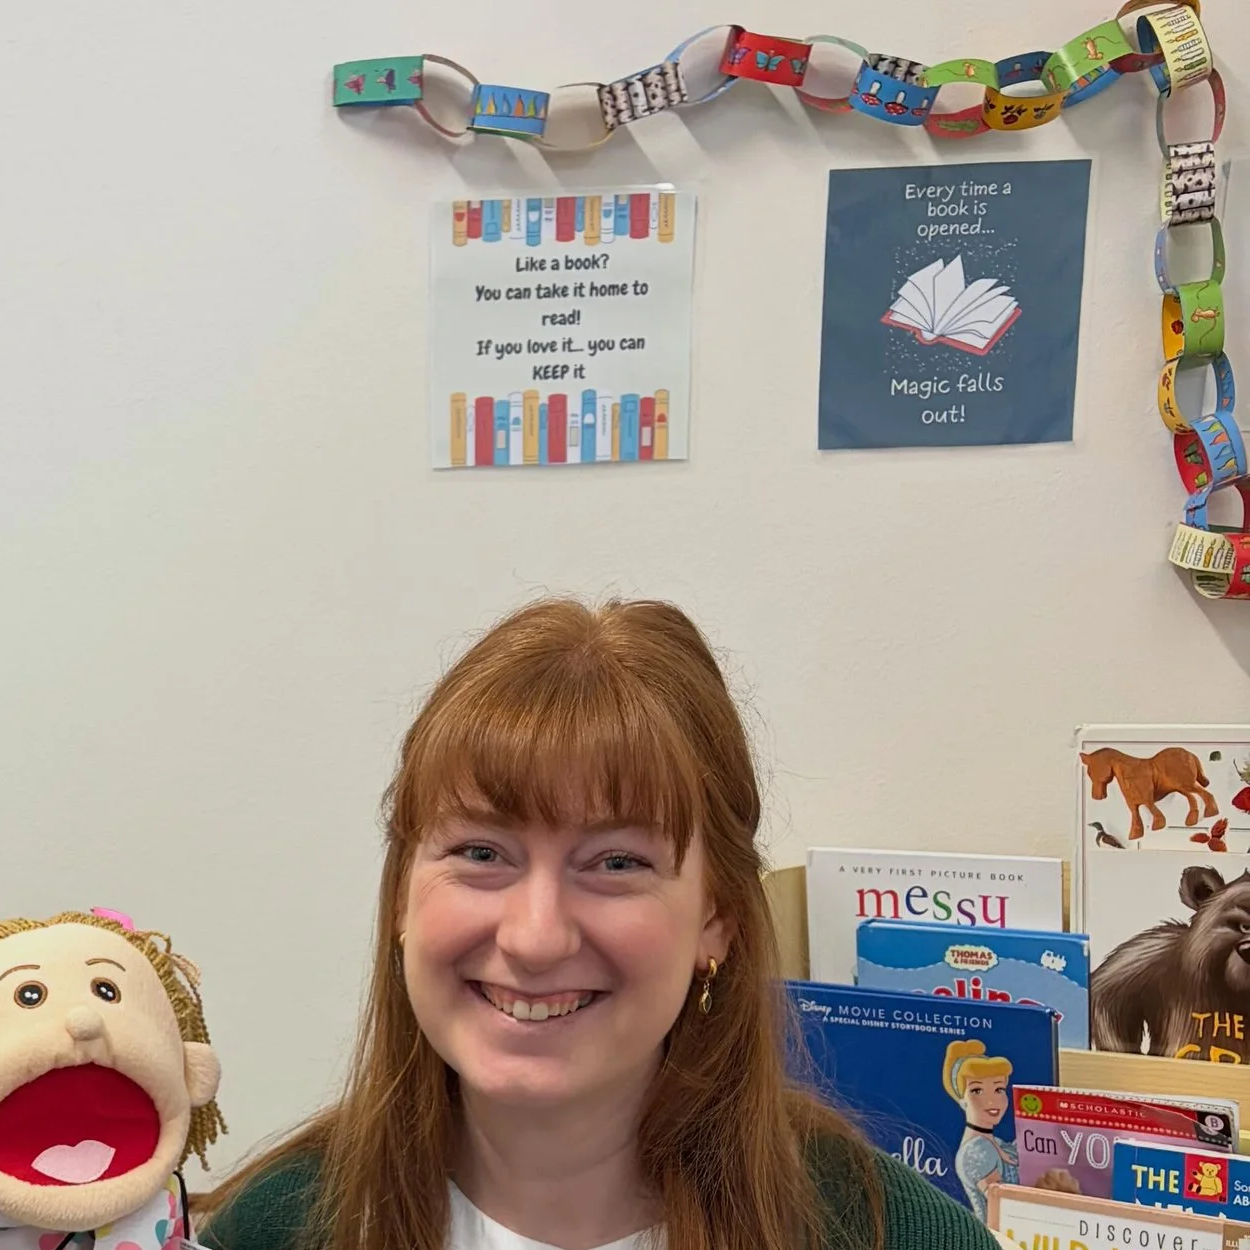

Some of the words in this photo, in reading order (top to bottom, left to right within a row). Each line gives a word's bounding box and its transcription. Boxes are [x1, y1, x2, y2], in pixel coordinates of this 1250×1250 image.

[905, 184, 955, 202] Every
[960, 181, 998, 196] time
[1002, 182, 1011, 195] a
[928, 199, 969, 217] book
[973, 200, 988, 215] is
[917, 217, 995, 241] opened...
[515, 257, 546, 272] Like
[551, 258, 560, 271] a
[565, 253, 609, 270] book?
[475, 285, 501, 301] You
[506, 286, 531, 300] can
[535, 283, 569, 299] take
[573, 282, 586, 298] it
[589, 281, 628, 297] home
[632, 280, 648, 295] to
[542, 309, 581, 326] read!
[476, 339, 492, 356] If
[495, 342, 522, 360] you
[527, 339, 558, 354] love
[588, 339, 615, 356] you
[620, 337, 645, 351] can
[532, 364, 569, 380] KEEP
[573, 364, 586, 379] it
[891, 376, 951, 400] Magic
[956, 372, 1004, 392] falls
[922, 404, 965, 424] out!
[852, 866, 882, 875] VERY
[889, 868, 922, 877] FIRST
[931, 870, 982, 880] PICTURE
[990, 873, 1024, 882] BOOK
[855, 885, 1009, 929] messy
[950, 949, 992, 960] THOMAS
[797, 998, 832, 1016] Disney
[838, 1005, 885, 1019] MOVIE
[893, 1009, 992, 1029] COLLECTION
[830, 1016, 860, 1025] SPECIAL
[862, 1020, 889, 1028] DISNEY
[891, 1022, 938, 1033] STORYBOOK
[939, 1027, 966, 1036] SERIES
[1192, 1012, 1245, 1040] THE
[1070, 1103, 1146, 1118] SCHOLASTIC
[1024, 1129, 1057, 1155] Can
[1060, 1129, 1116, 1170] YO
[1131, 1164, 1180, 1194] THE
